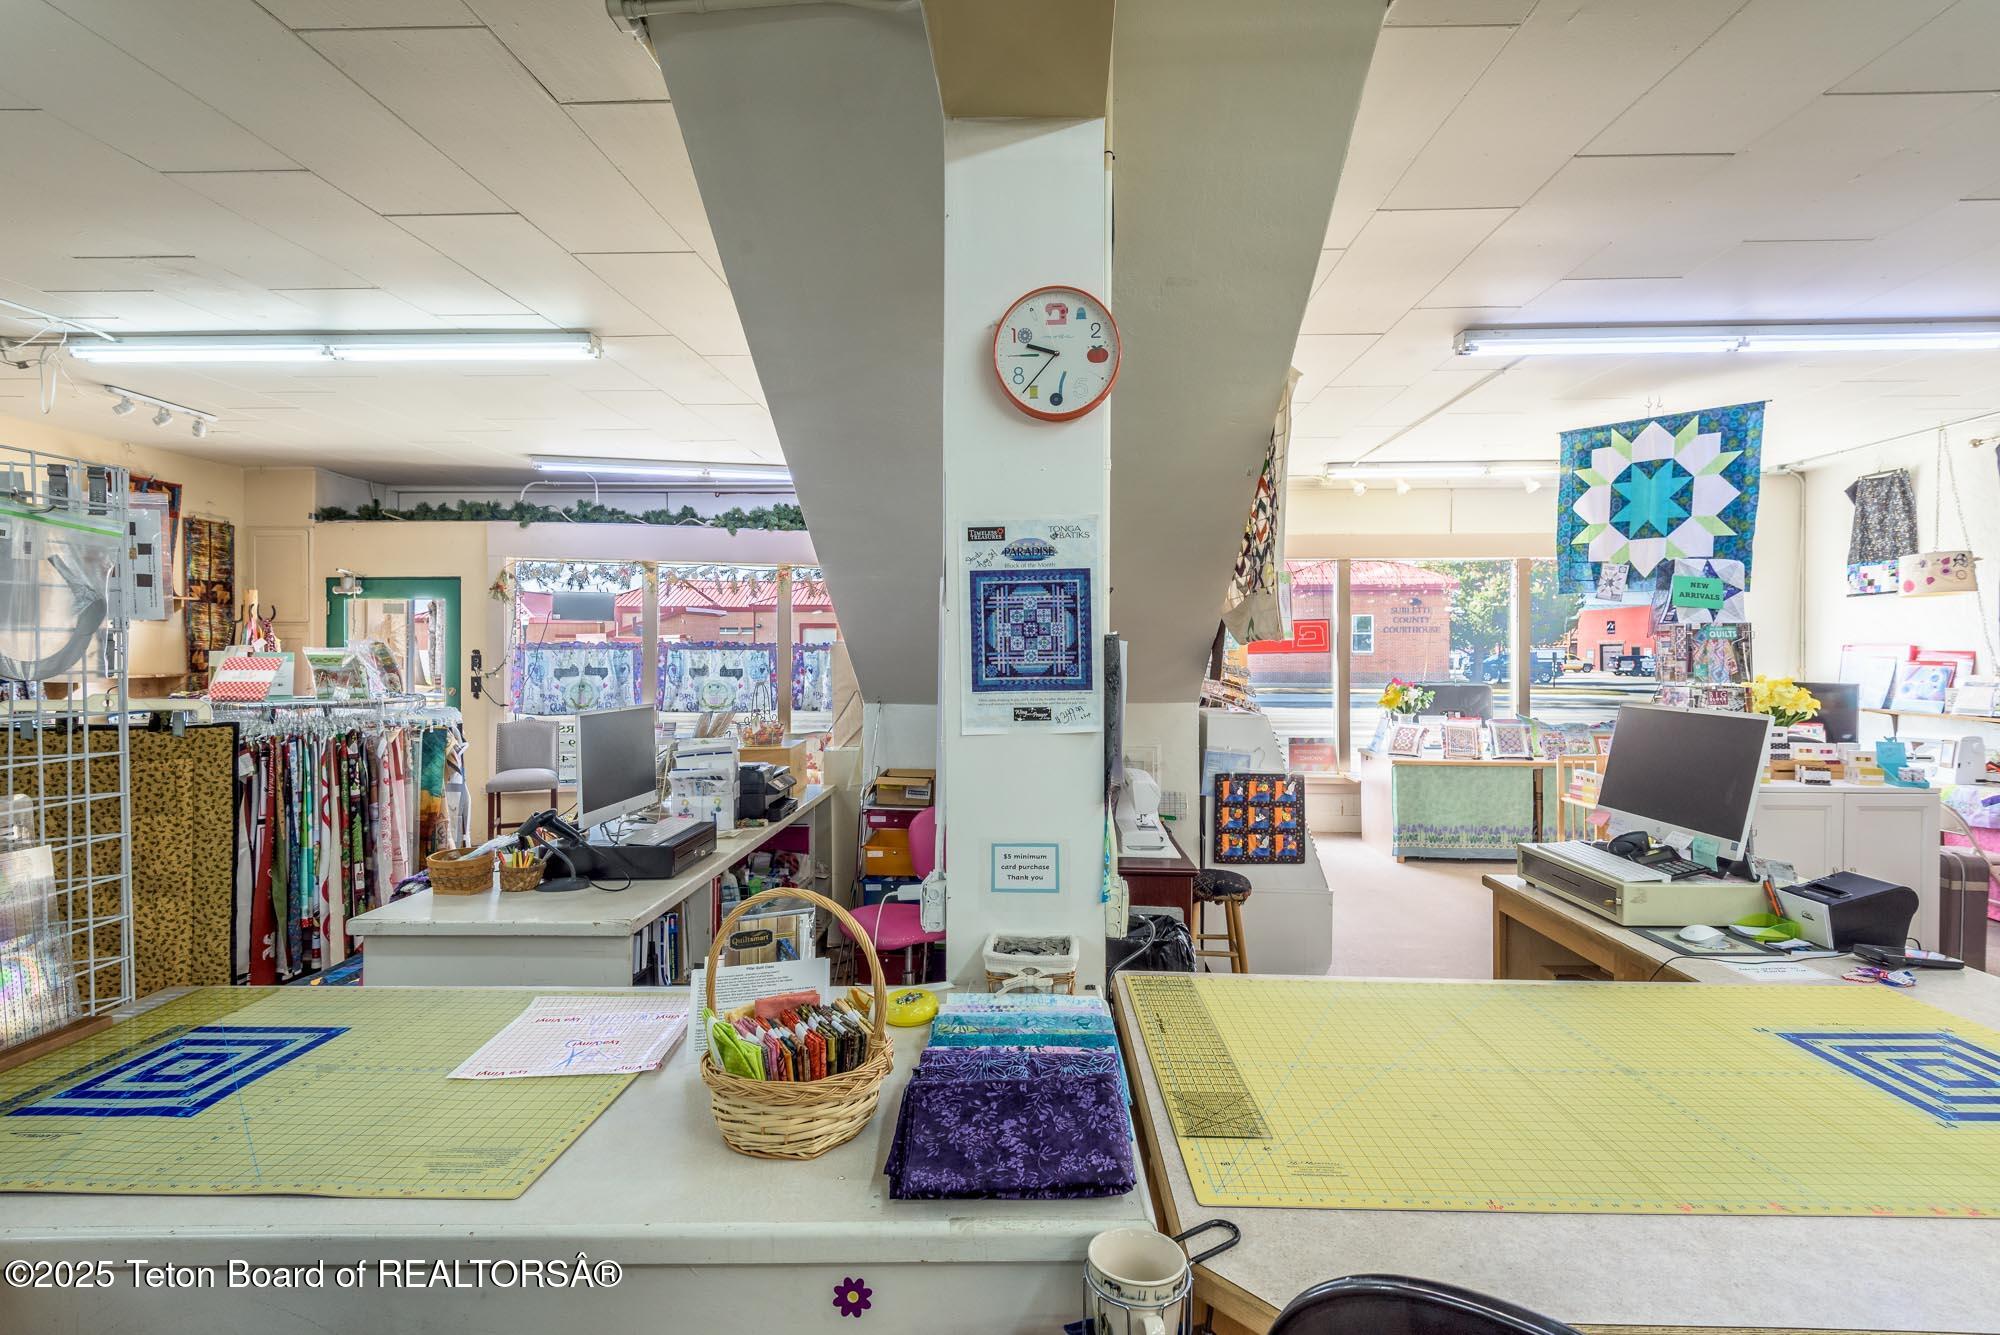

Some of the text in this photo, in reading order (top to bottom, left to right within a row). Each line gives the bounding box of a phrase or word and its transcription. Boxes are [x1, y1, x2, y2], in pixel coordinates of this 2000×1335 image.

[1090, 322, 1101, 339] 2
[1059, 531, 1090, 539] BATIKS
[1003, 545, 1055, 557] PARADISE
[1679, 591, 1720, 601] ARRIVALS
[1709, 630, 1737, 638] QUILTS
[731, 934, 769, 945] Quiltsmart
